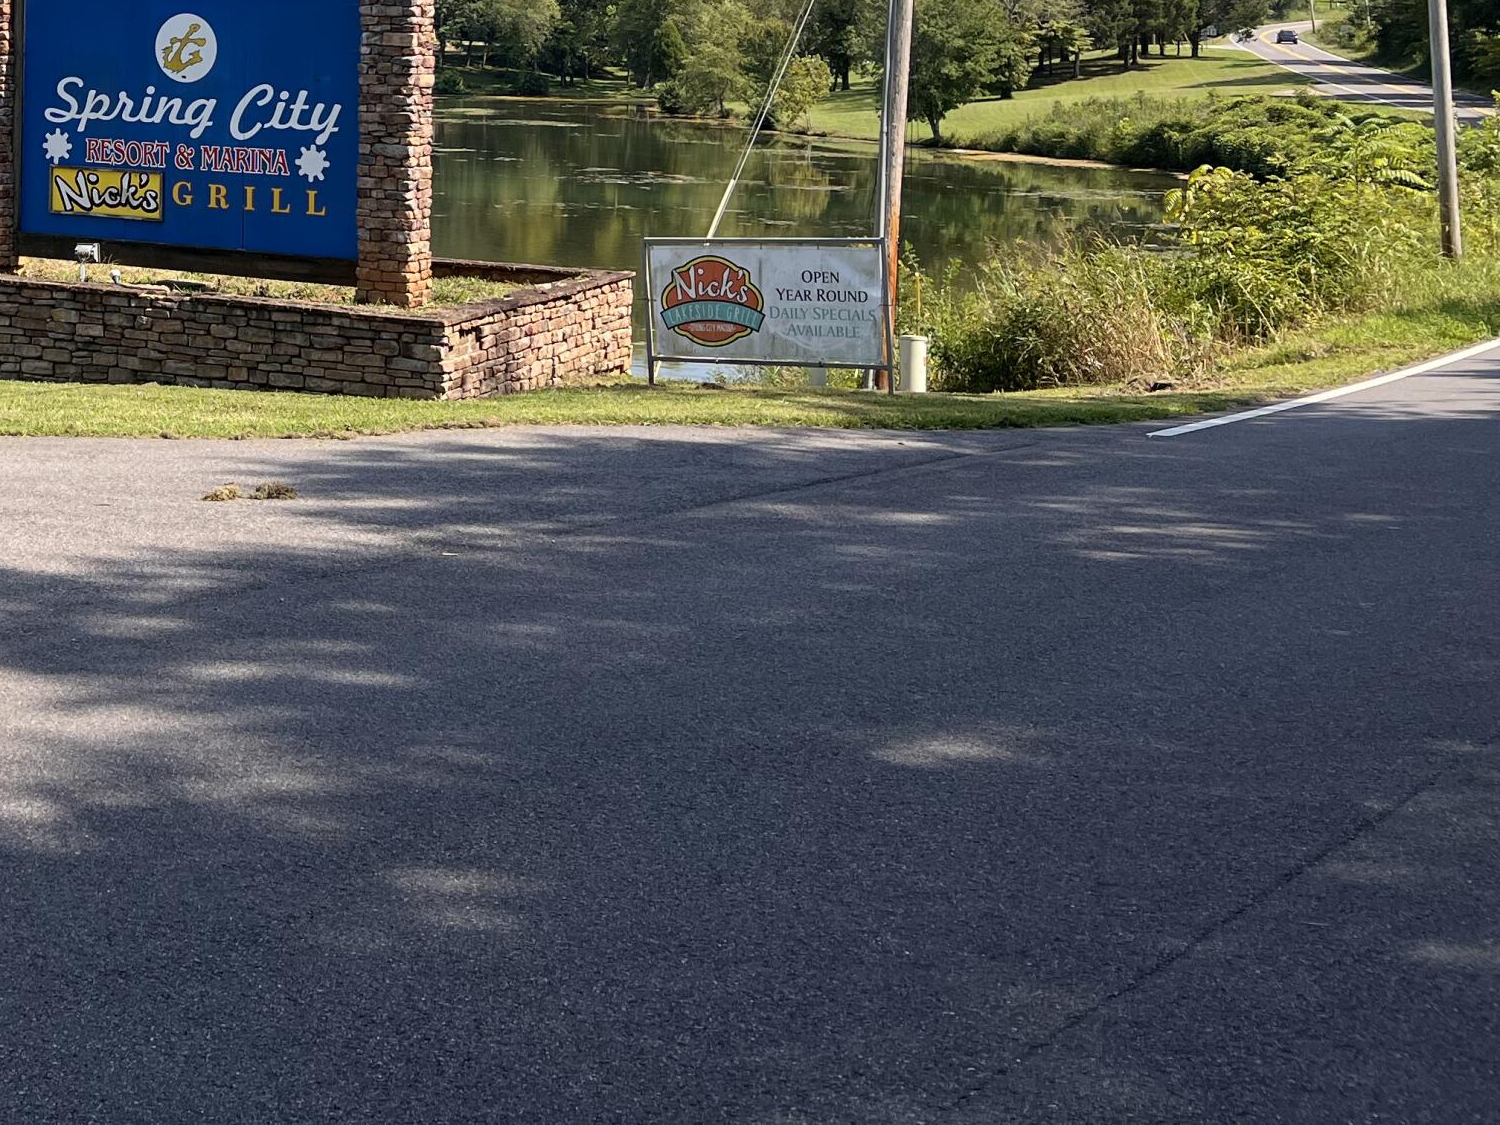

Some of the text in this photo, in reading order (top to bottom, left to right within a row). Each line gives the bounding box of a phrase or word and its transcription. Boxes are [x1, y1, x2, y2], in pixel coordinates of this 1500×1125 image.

[44, 77, 342, 146] Spring City
[85, 138, 290, 175] RESORT & MARINA
[54, 170, 327, 217] Nick's GRILL
[673, 265, 748, 303] Nick's
[801, 270, 839, 283] OPEN
[776, 288, 868, 303] YEAR ROUND
[668, 304, 759, 327] LAKESIDE GRILL
[770, 306, 877, 322] DAILY SPECIALS
[787, 323, 860, 338] AVAILABLE
